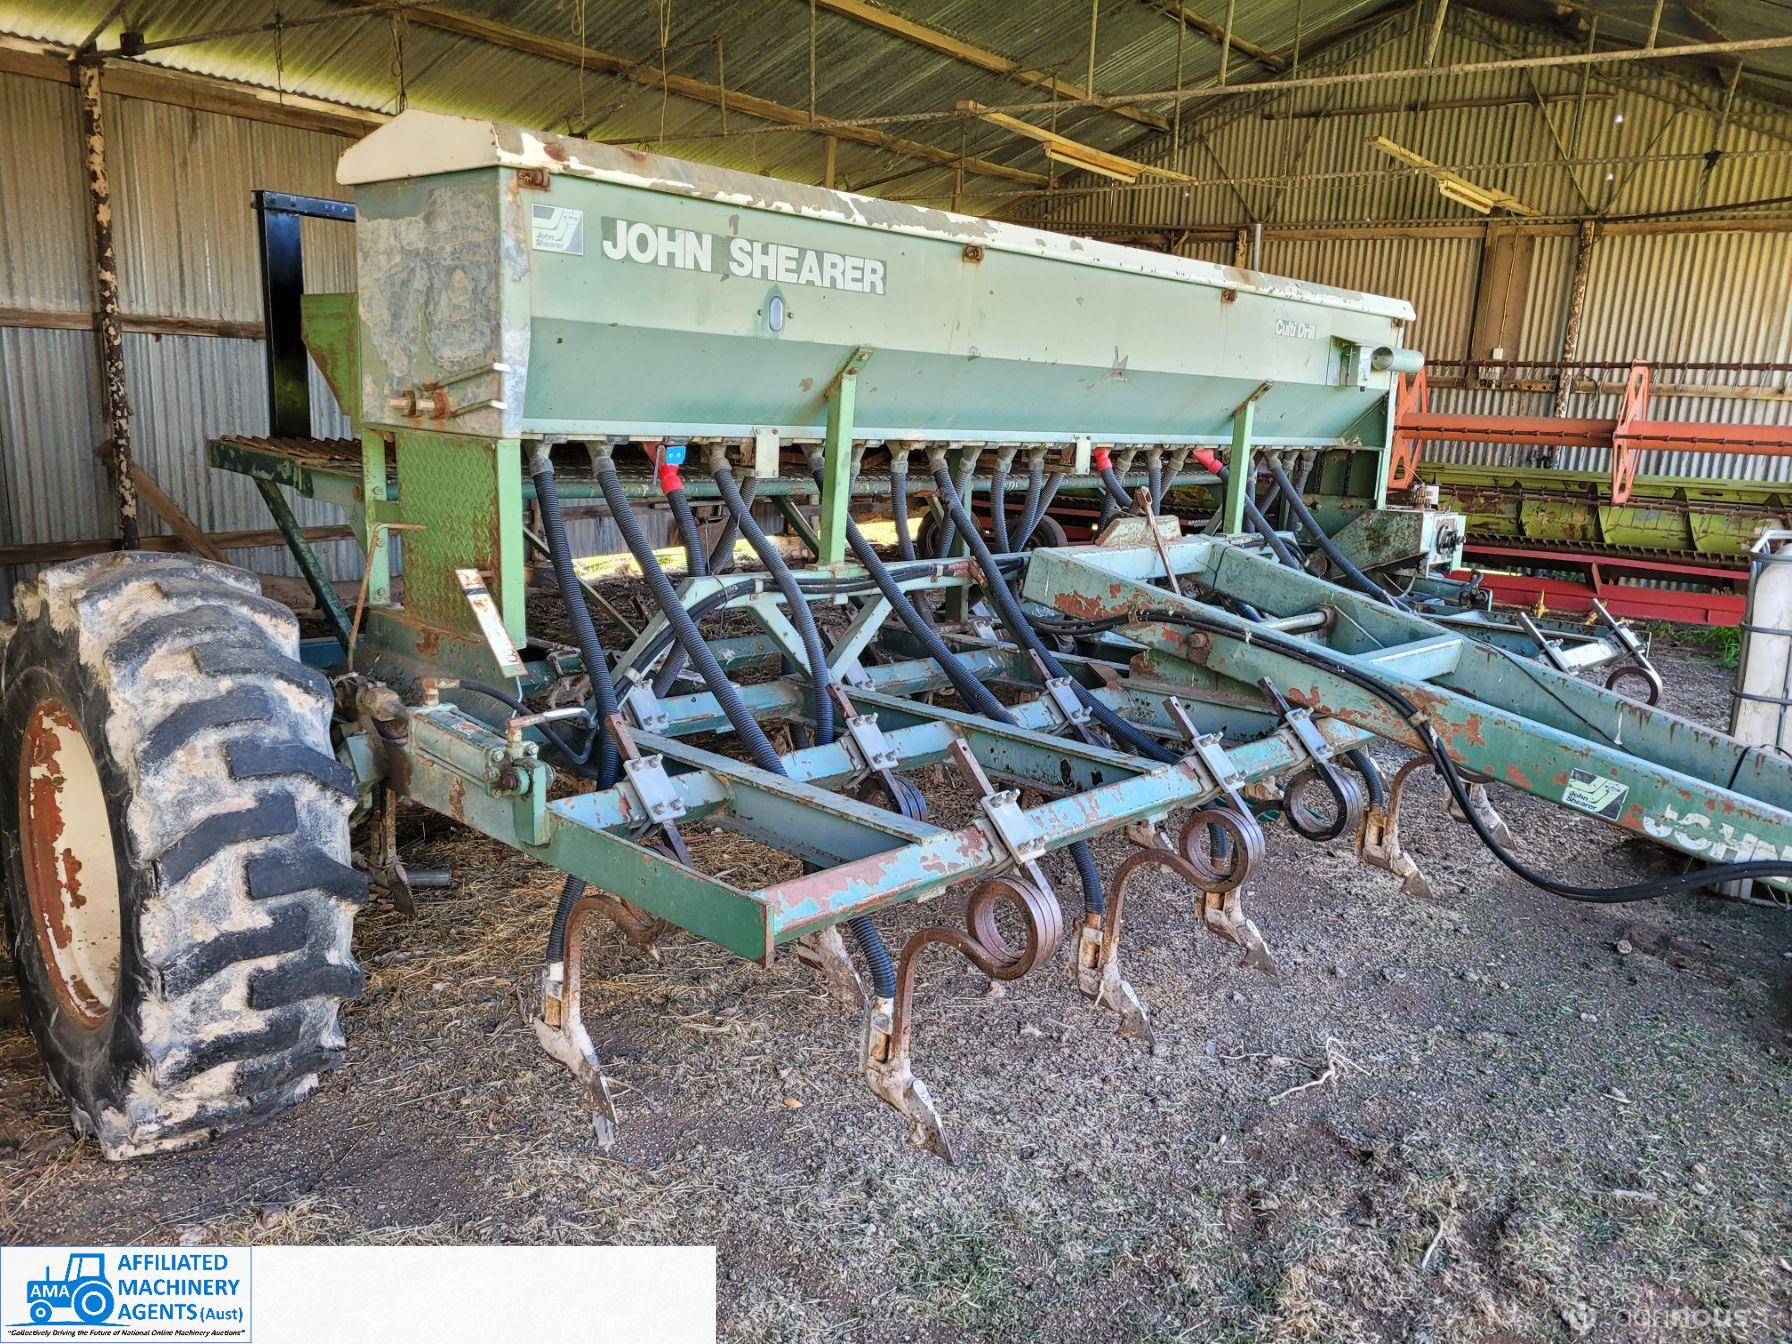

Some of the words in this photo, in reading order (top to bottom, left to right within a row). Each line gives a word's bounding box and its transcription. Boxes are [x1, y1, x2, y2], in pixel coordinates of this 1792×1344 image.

[536, 231, 554, 241] John
[535, 238, 563, 249] Shearer
[602, 219, 713, 273] JOHN
[728, 237, 885, 295] SHEARER
[1275, 319, 1297, 337] Culti
[1297, 322, 1316, 340] Drill
[1569, 790, 1589, 801] John
[1566, 795, 1597, 811] Shearer
